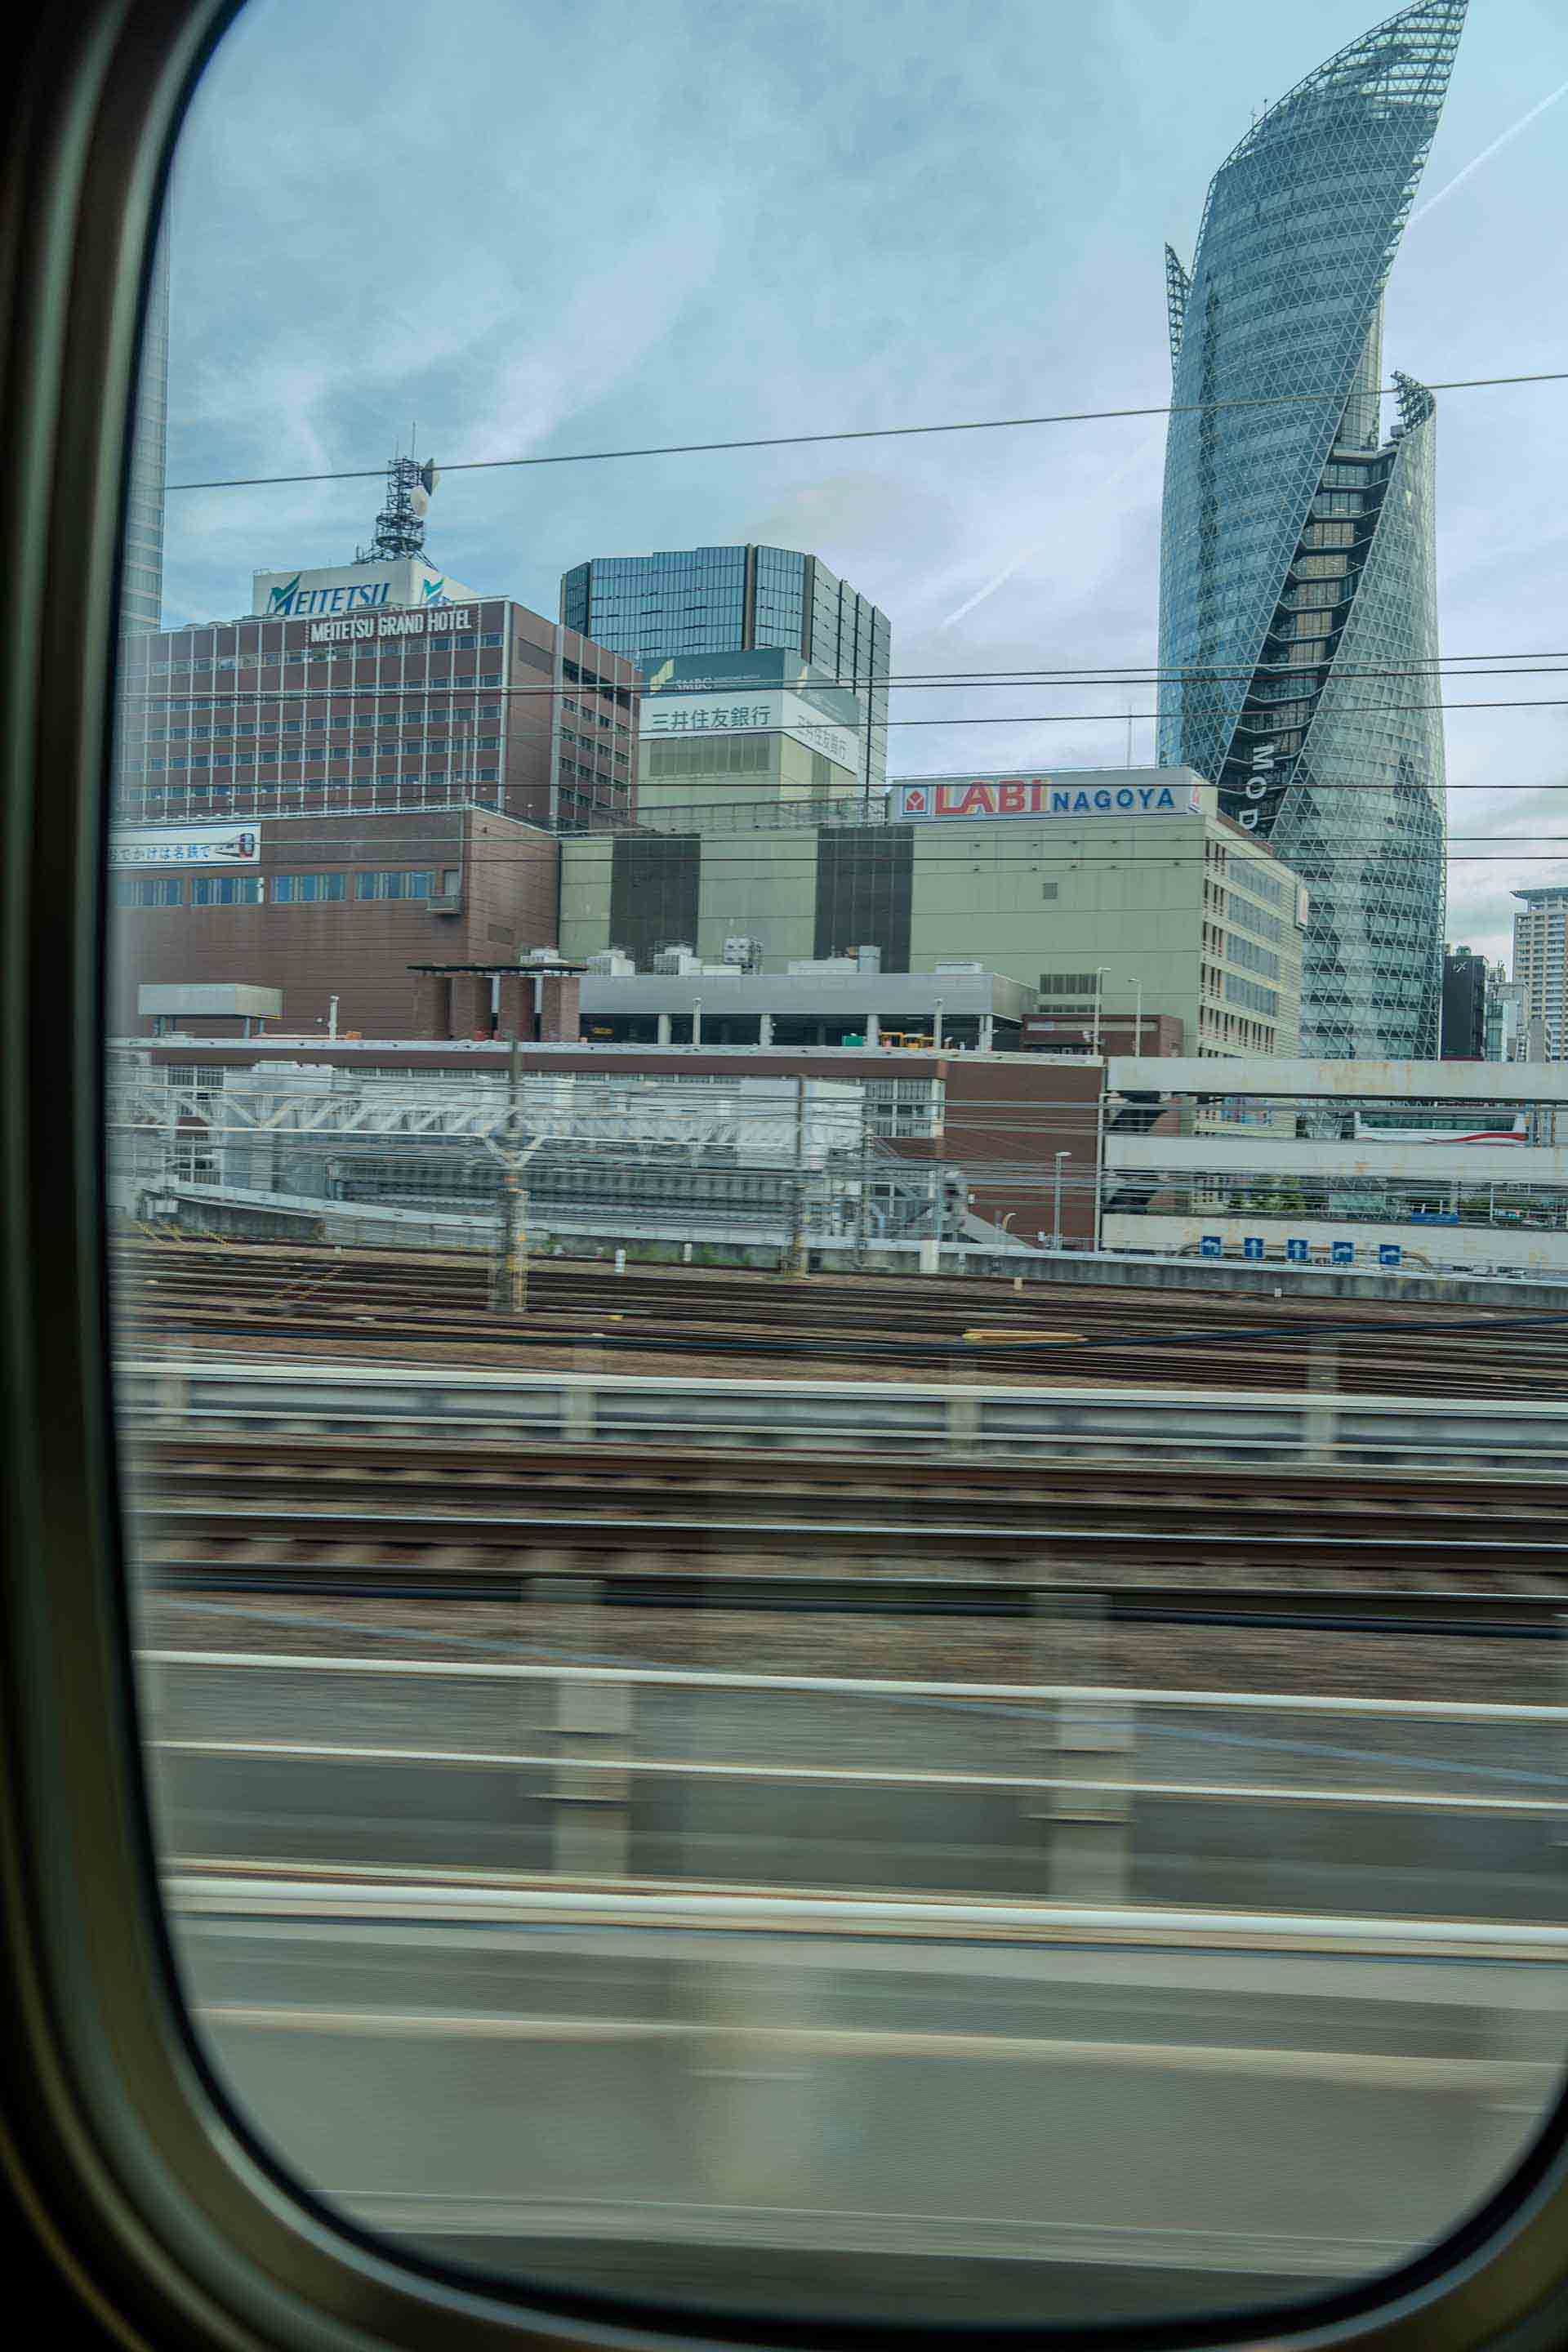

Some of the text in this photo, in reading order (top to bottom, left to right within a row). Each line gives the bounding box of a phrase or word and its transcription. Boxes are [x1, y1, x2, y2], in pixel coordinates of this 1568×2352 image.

[267, 574, 390, 615] MEITETSU
[310, 608, 472, 643] MEITETSU GRAND HOTEL
[652, 706, 771, 731] 三井住友銀行
[934, 779, 1045, 815] LABI
[1052, 786, 1176, 813] NAGOYA
